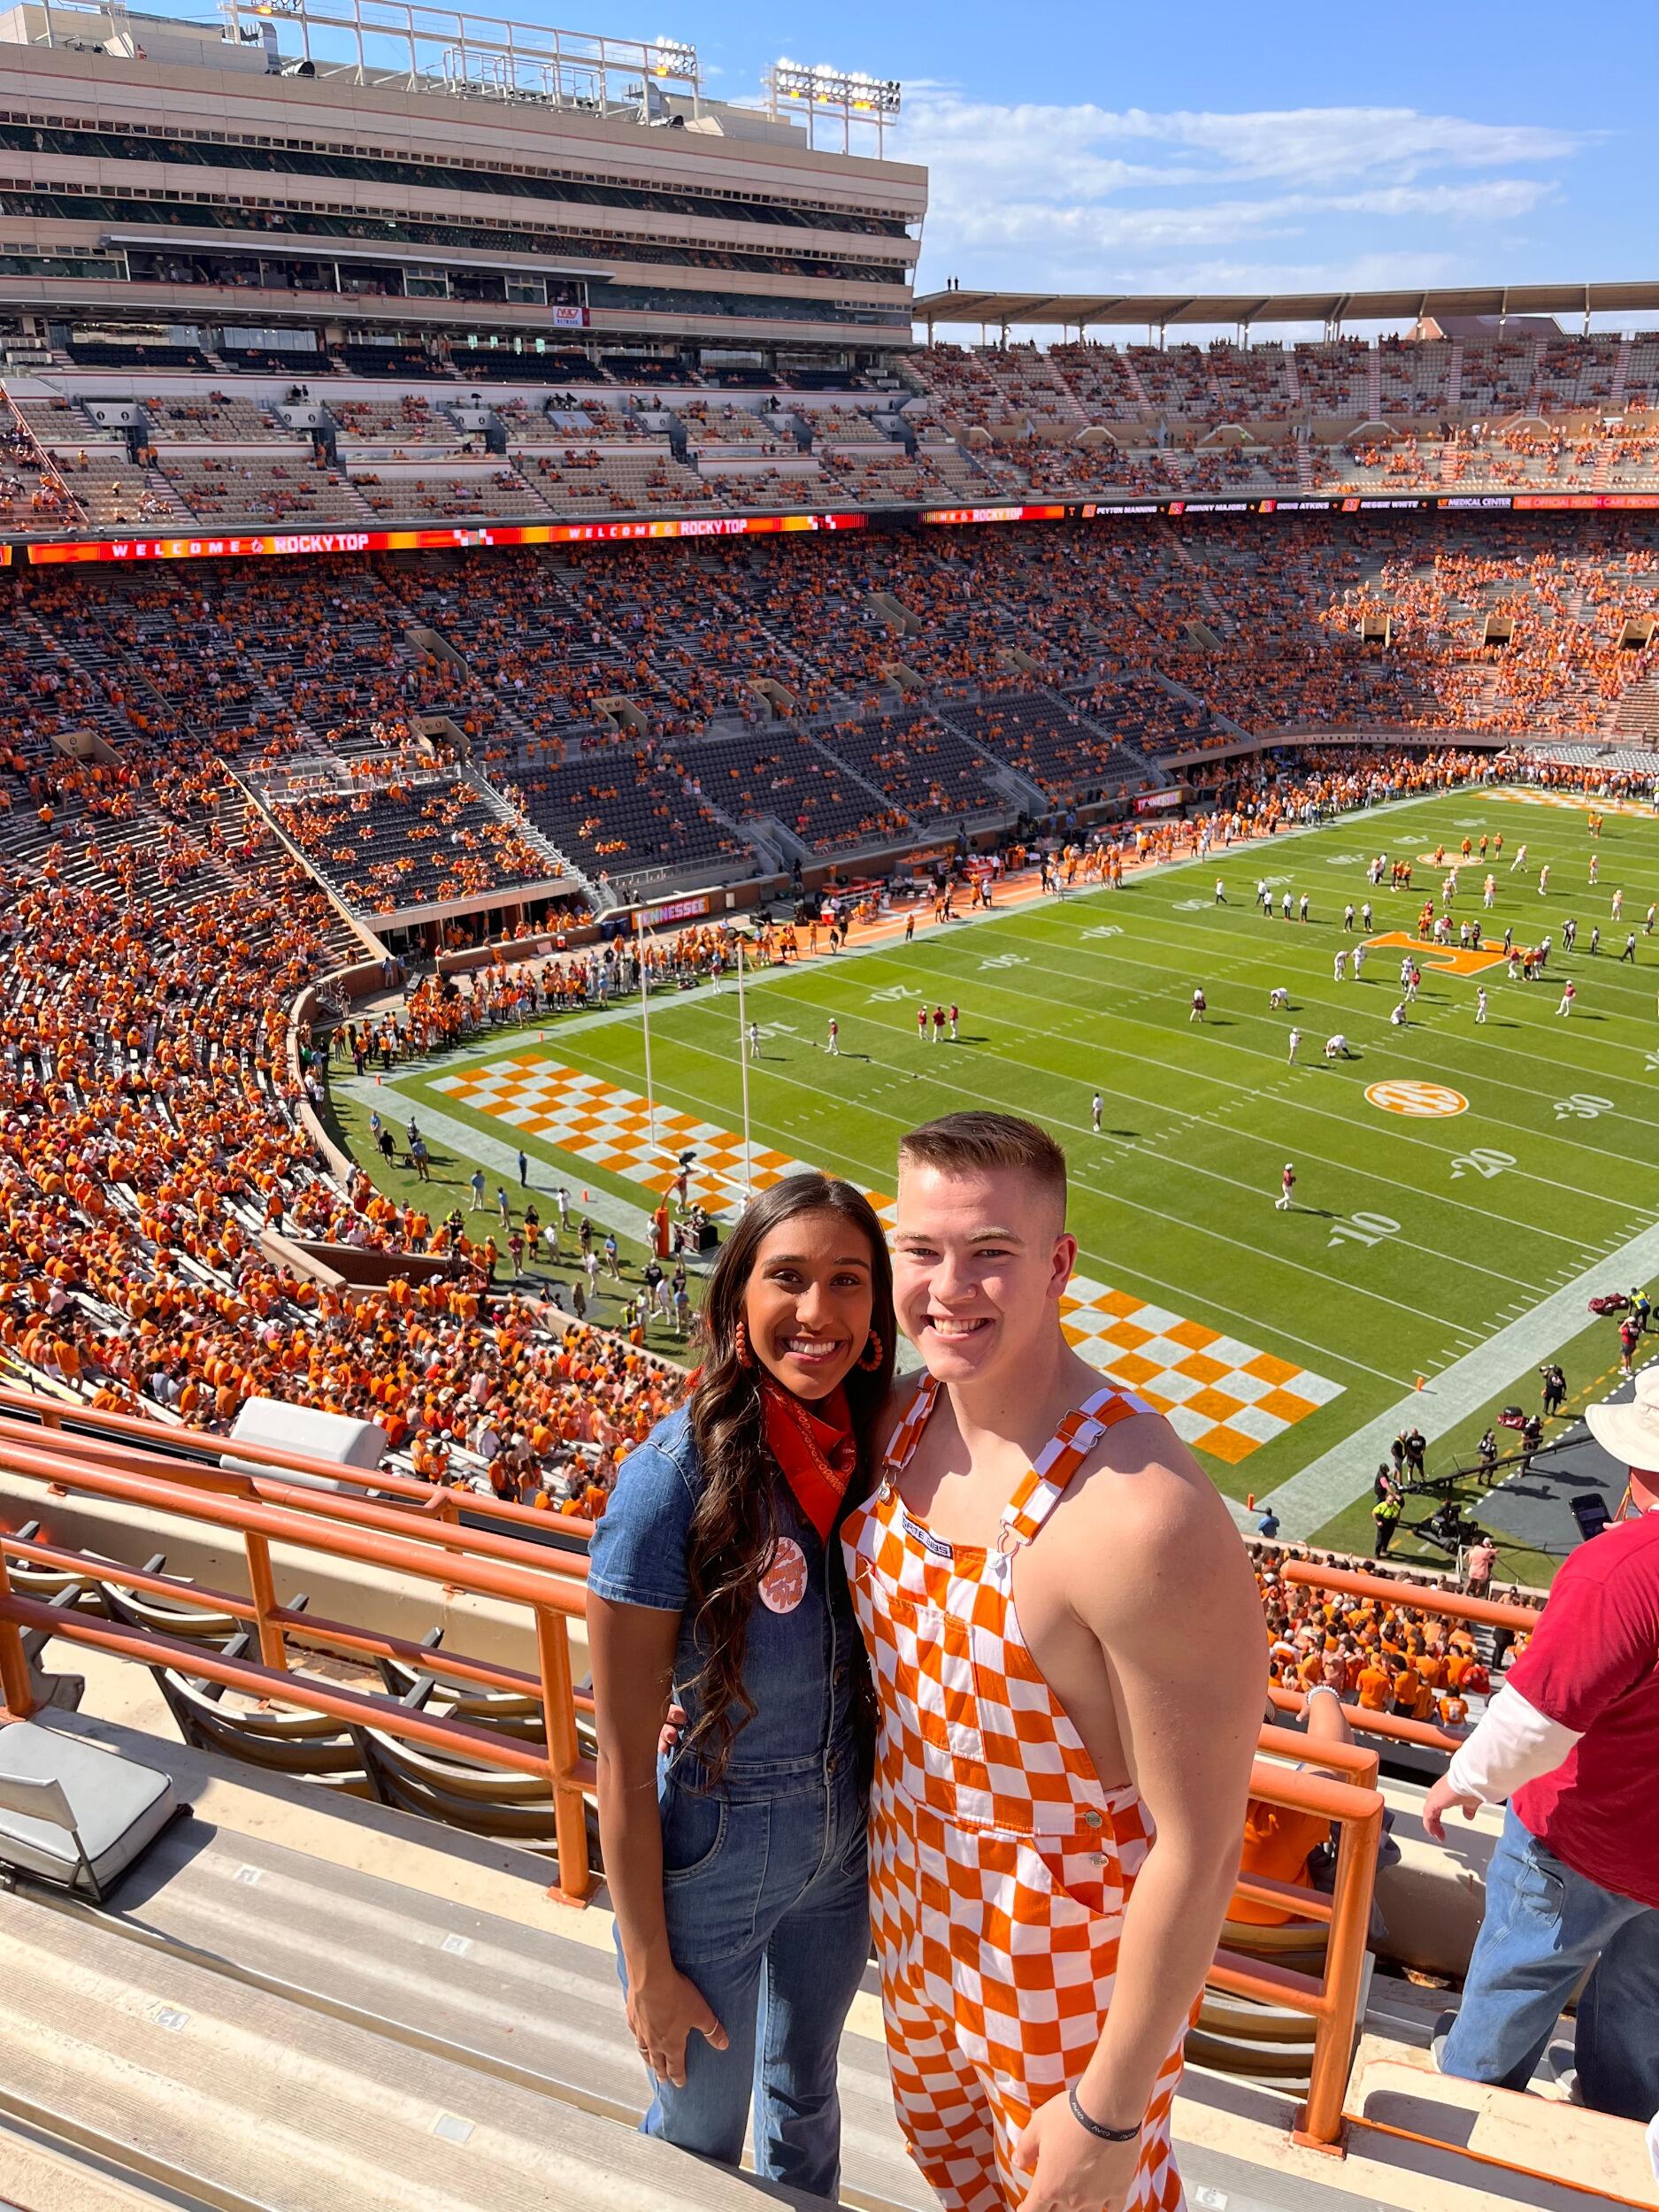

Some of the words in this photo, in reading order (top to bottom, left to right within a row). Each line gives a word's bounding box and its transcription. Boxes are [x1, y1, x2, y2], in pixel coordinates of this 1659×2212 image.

[1185, 504, 1215, 513] JOHNNY
[1215, 503, 1247, 512] MAJORS
[569, 525, 657, 538] WELCOME
[680, 520, 723, 535] ROCKY
[725, 519, 747, 534] TOP
[112, 541, 240, 557] WELCOME
[251, 540, 265, 553] to
[273, 536, 332, 554] ROCKY
[336, 534, 369, 550] TOP
[1553, 1093, 1614, 1119] 30
[1450, 1148, 1517, 1179] 20
[1329, 1211, 1402, 1248] 10
